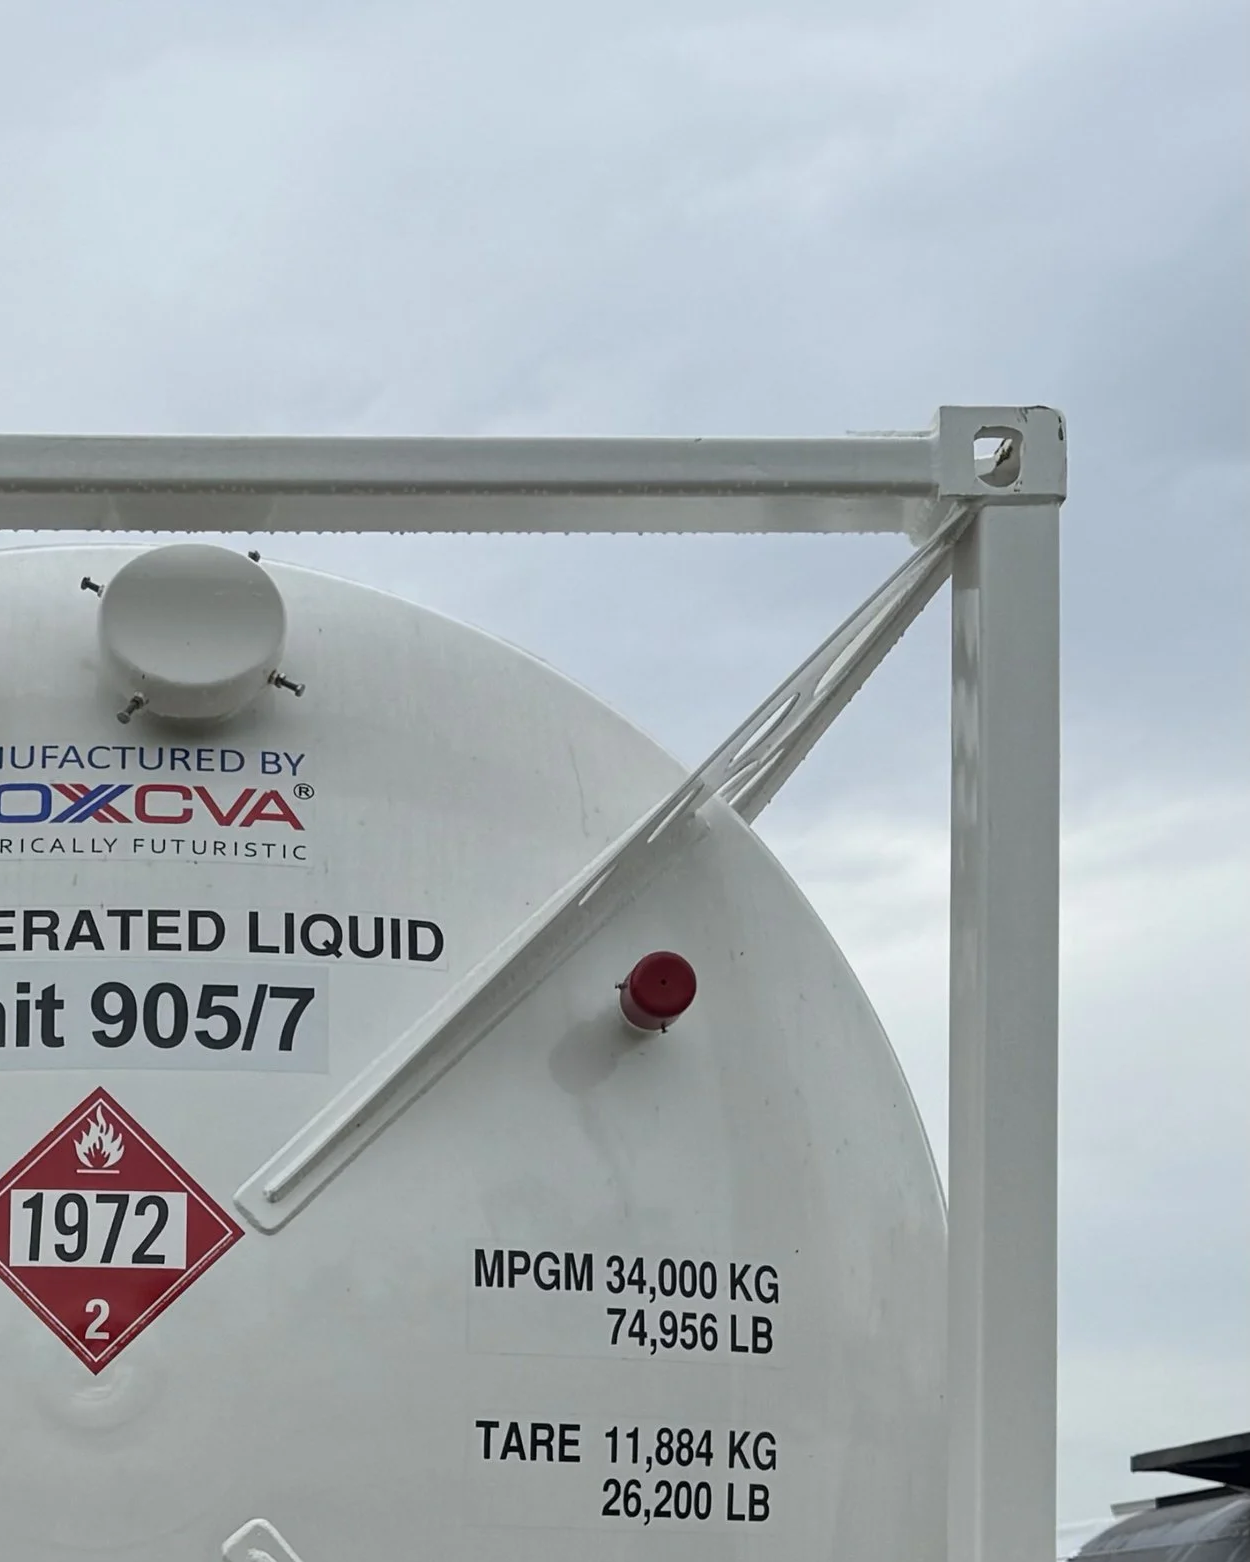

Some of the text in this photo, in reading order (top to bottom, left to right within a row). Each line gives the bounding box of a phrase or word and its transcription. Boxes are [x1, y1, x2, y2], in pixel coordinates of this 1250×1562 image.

[261, 751, 306, 776] BY
[133, 838, 308, 860] FUTURISTIC
[249, 911, 445, 963] LIQUID
[89, 981, 316, 1052] 905/7
[21, 1193, 168, 1267] 1972
[474, 1249, 780, 1304] MPGM 34,000 KG
[85, 1298, 110, 1340] 2
[607, 1308, 774, 1355] 74,956 LB
[475, 1420, 777, 1473] TARE 11,884 KG
[602, 1478, 770, 1525] 26,200 LB
